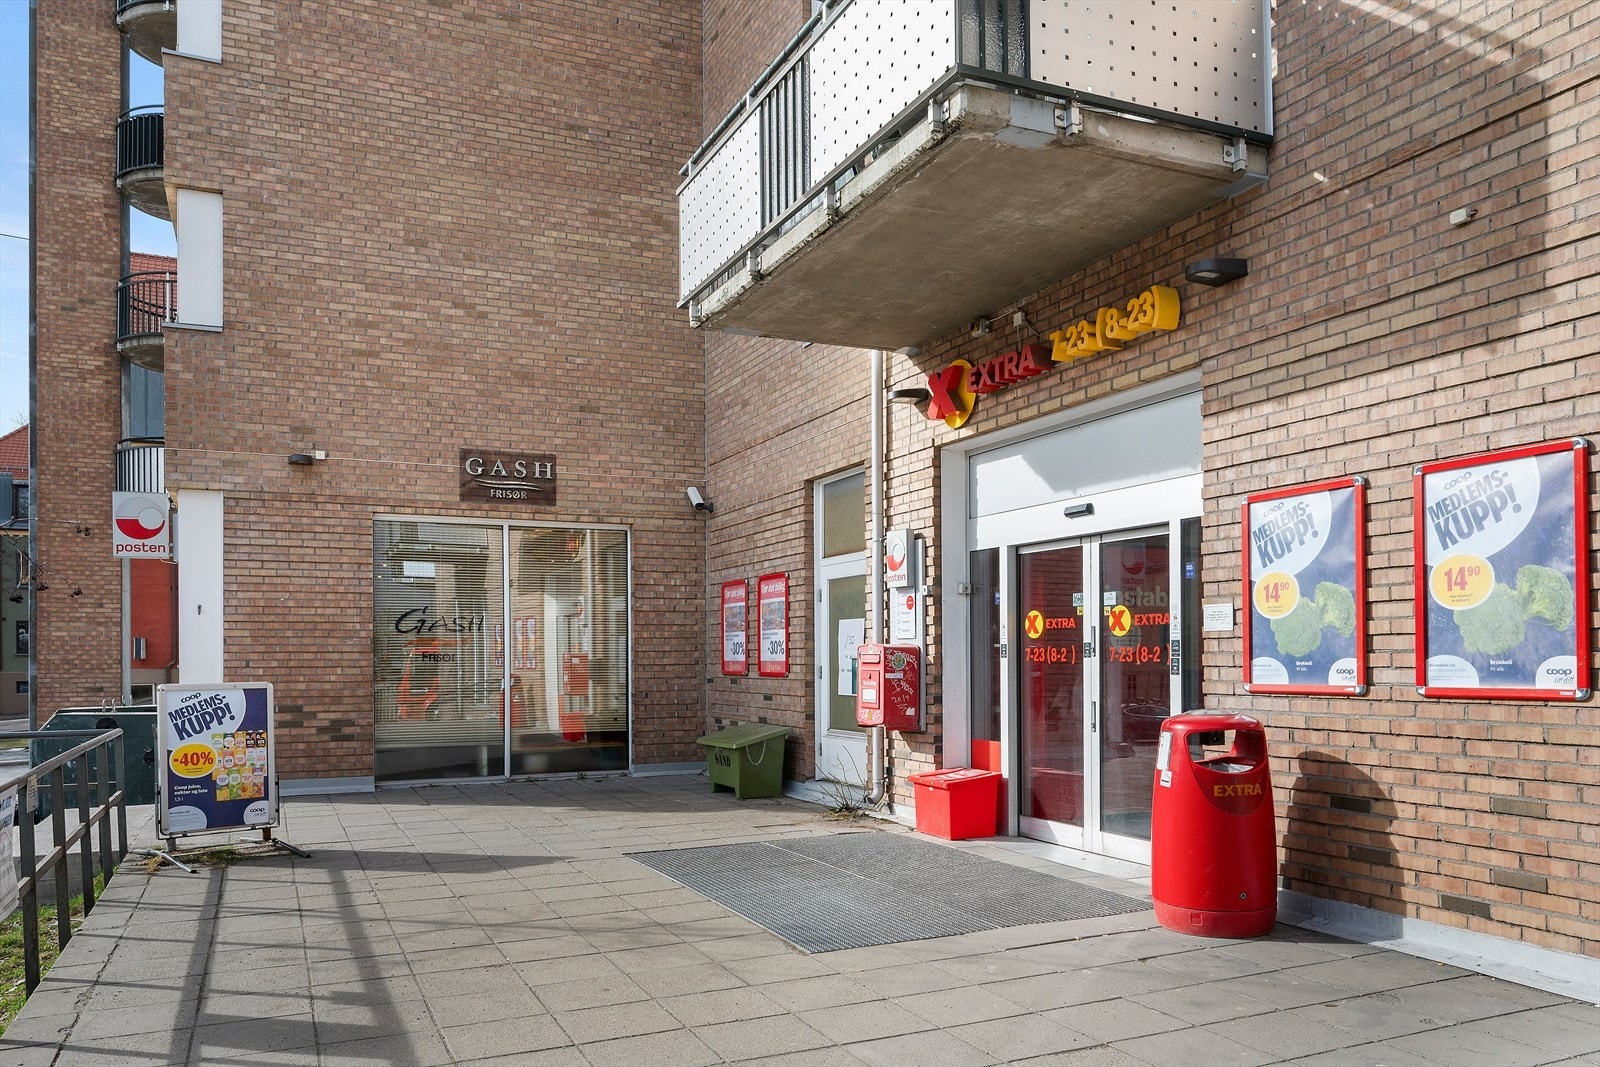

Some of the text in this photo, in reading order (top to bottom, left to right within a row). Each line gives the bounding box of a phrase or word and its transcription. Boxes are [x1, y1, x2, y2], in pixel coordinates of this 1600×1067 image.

[966, 344, 1043, 394] EXTRA
[1049, 319, 1092, 361] 7-23
[1096, 285, 1170, 349] (8-23)
[465, 457, 553, 479] GASH
[1444, 471, 1472, 490] coop
[490, 489, 528, 499] FRISØR
[1427, 469, 1509, 523] MEDLEMS-
[1263, 501, 1284, 517] coop
[1434, 482, 1522, 551] KUPP!
[1252, 501, 1310, 545] MEDLEMS-
[116, 542, 166, 555] posten
[1256, 512, 1319, 569] KUPP!
[1046, 617, 1076, 629] EXTRA
[1135, 613, 1170, 625] EXTRA
[768, 640, 784, 655] -30%
[1025, 647, 1045, 662] 7-23
[1109, 646, 1134, 662] 7-23
[1546, 668, 1572, 676] coop
[181, 692, 202, 703] coop
[168, 693, 227, 723] MEDLEMS-
[173, 702, 236, 742] KUPP!
[173, 751, 214, 767] -40%
[714, 753, 731, 767] SAND
[1213, 783, 1262, 797] EXTRA
